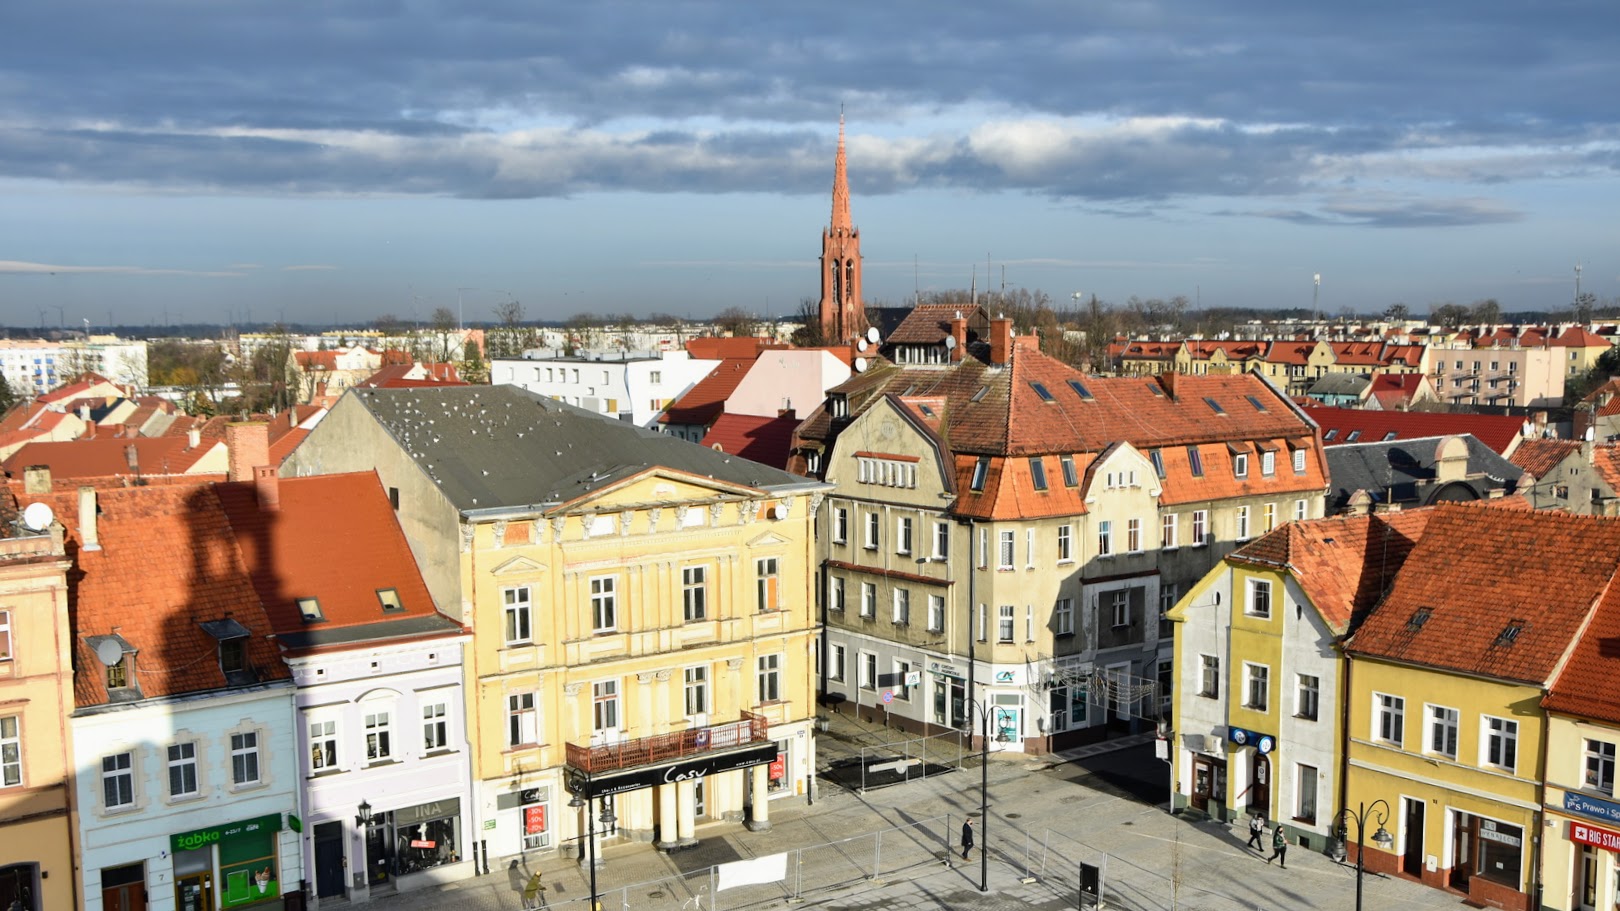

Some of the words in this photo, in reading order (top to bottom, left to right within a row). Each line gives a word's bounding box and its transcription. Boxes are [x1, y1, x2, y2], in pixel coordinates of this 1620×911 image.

[664, 766, 707, 783] Casu
[1583, 802, 1605, 814] Prawo
[178, 831, 220, 848] żabka
[1589, 829, 1601, 844] BIG
